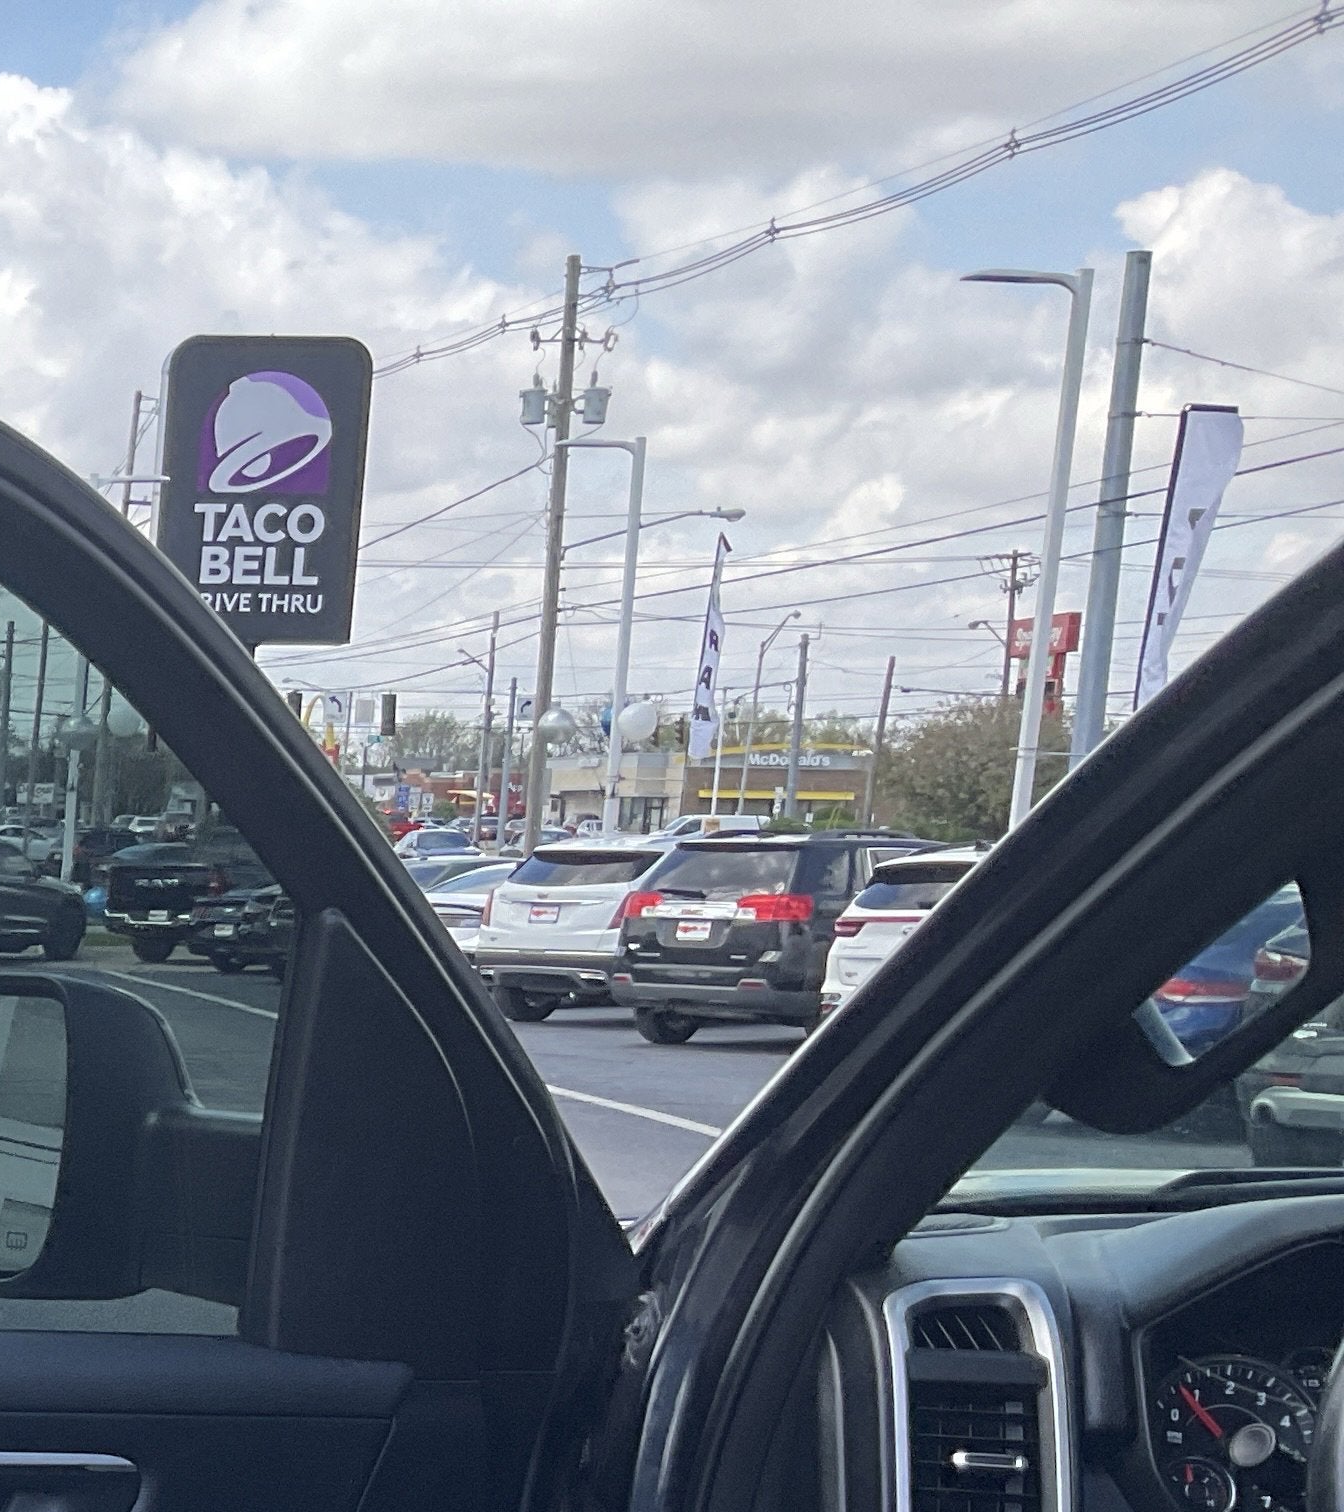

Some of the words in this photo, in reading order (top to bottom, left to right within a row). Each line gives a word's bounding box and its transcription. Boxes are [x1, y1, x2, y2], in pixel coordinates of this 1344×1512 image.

[193, 503, 325, 544] TACO
[198, 546, 319, 585] BELL
[199, 592, 252, 613] RIVE
[257, 593, 324, 613] THRU
[749, 753, 830, 767] McDoald's
[1224, 1380, 1236, 1395] 2
[1256, 1391, 1267, 1406] 3
[1170, 1408, 1180, 1421] 0
[1279, 1415, 1292, 1428] 4
[1260, 1495, 1272, 1509] 7
